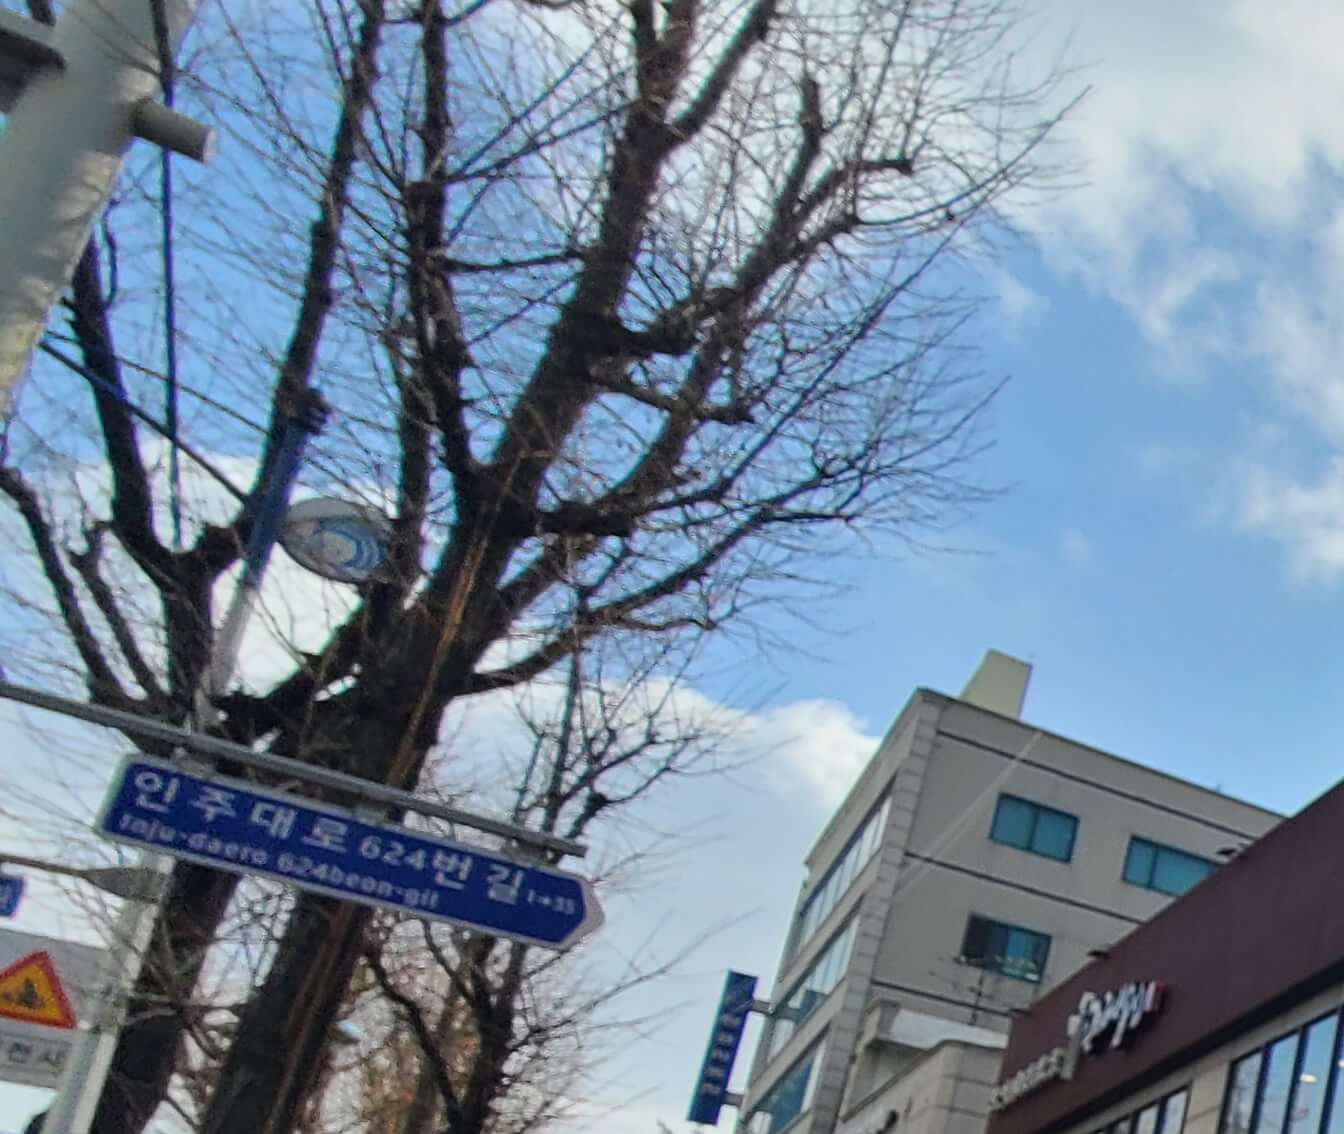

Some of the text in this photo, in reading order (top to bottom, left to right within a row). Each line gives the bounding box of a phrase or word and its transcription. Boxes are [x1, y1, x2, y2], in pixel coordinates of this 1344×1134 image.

[133, 770, 349, 853] 인주대로
[359, 833, 525, 905] 624번길
[276, 851, 440, 909] 624beon-gil
